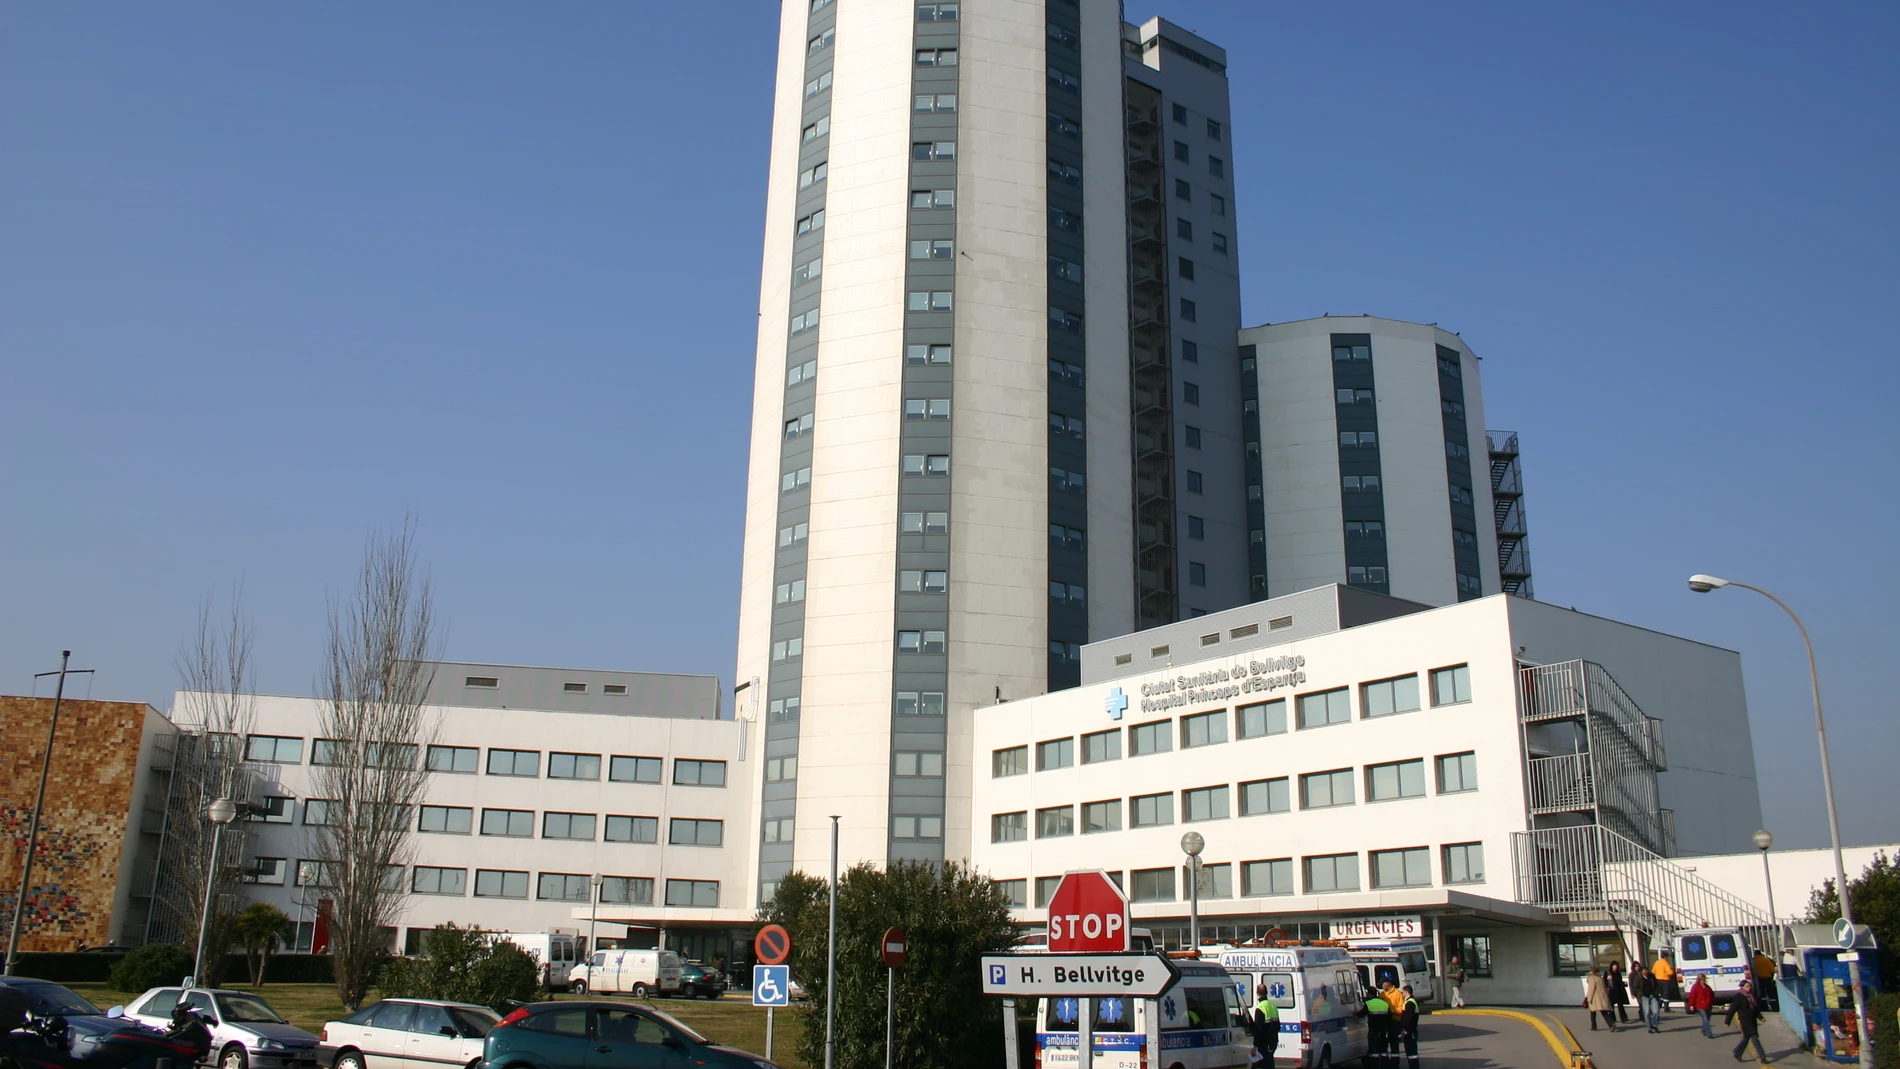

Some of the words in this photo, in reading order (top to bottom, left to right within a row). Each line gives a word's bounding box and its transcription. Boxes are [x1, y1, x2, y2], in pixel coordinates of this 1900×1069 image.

[1231, 664, 1248, 680] de
[1250, 655, 1306, 676] Bellvitge
[1141, 691, 1188, 713] Hospital
[1050, 913, 1122, 940] STOP
[1336, 917, 1414, 935] URGÈNCIES
[993, 967, 1004, 984] P
[1021, 966, 1042, 984] H.
[1054, 965, 1145, 986] Bellvitge
